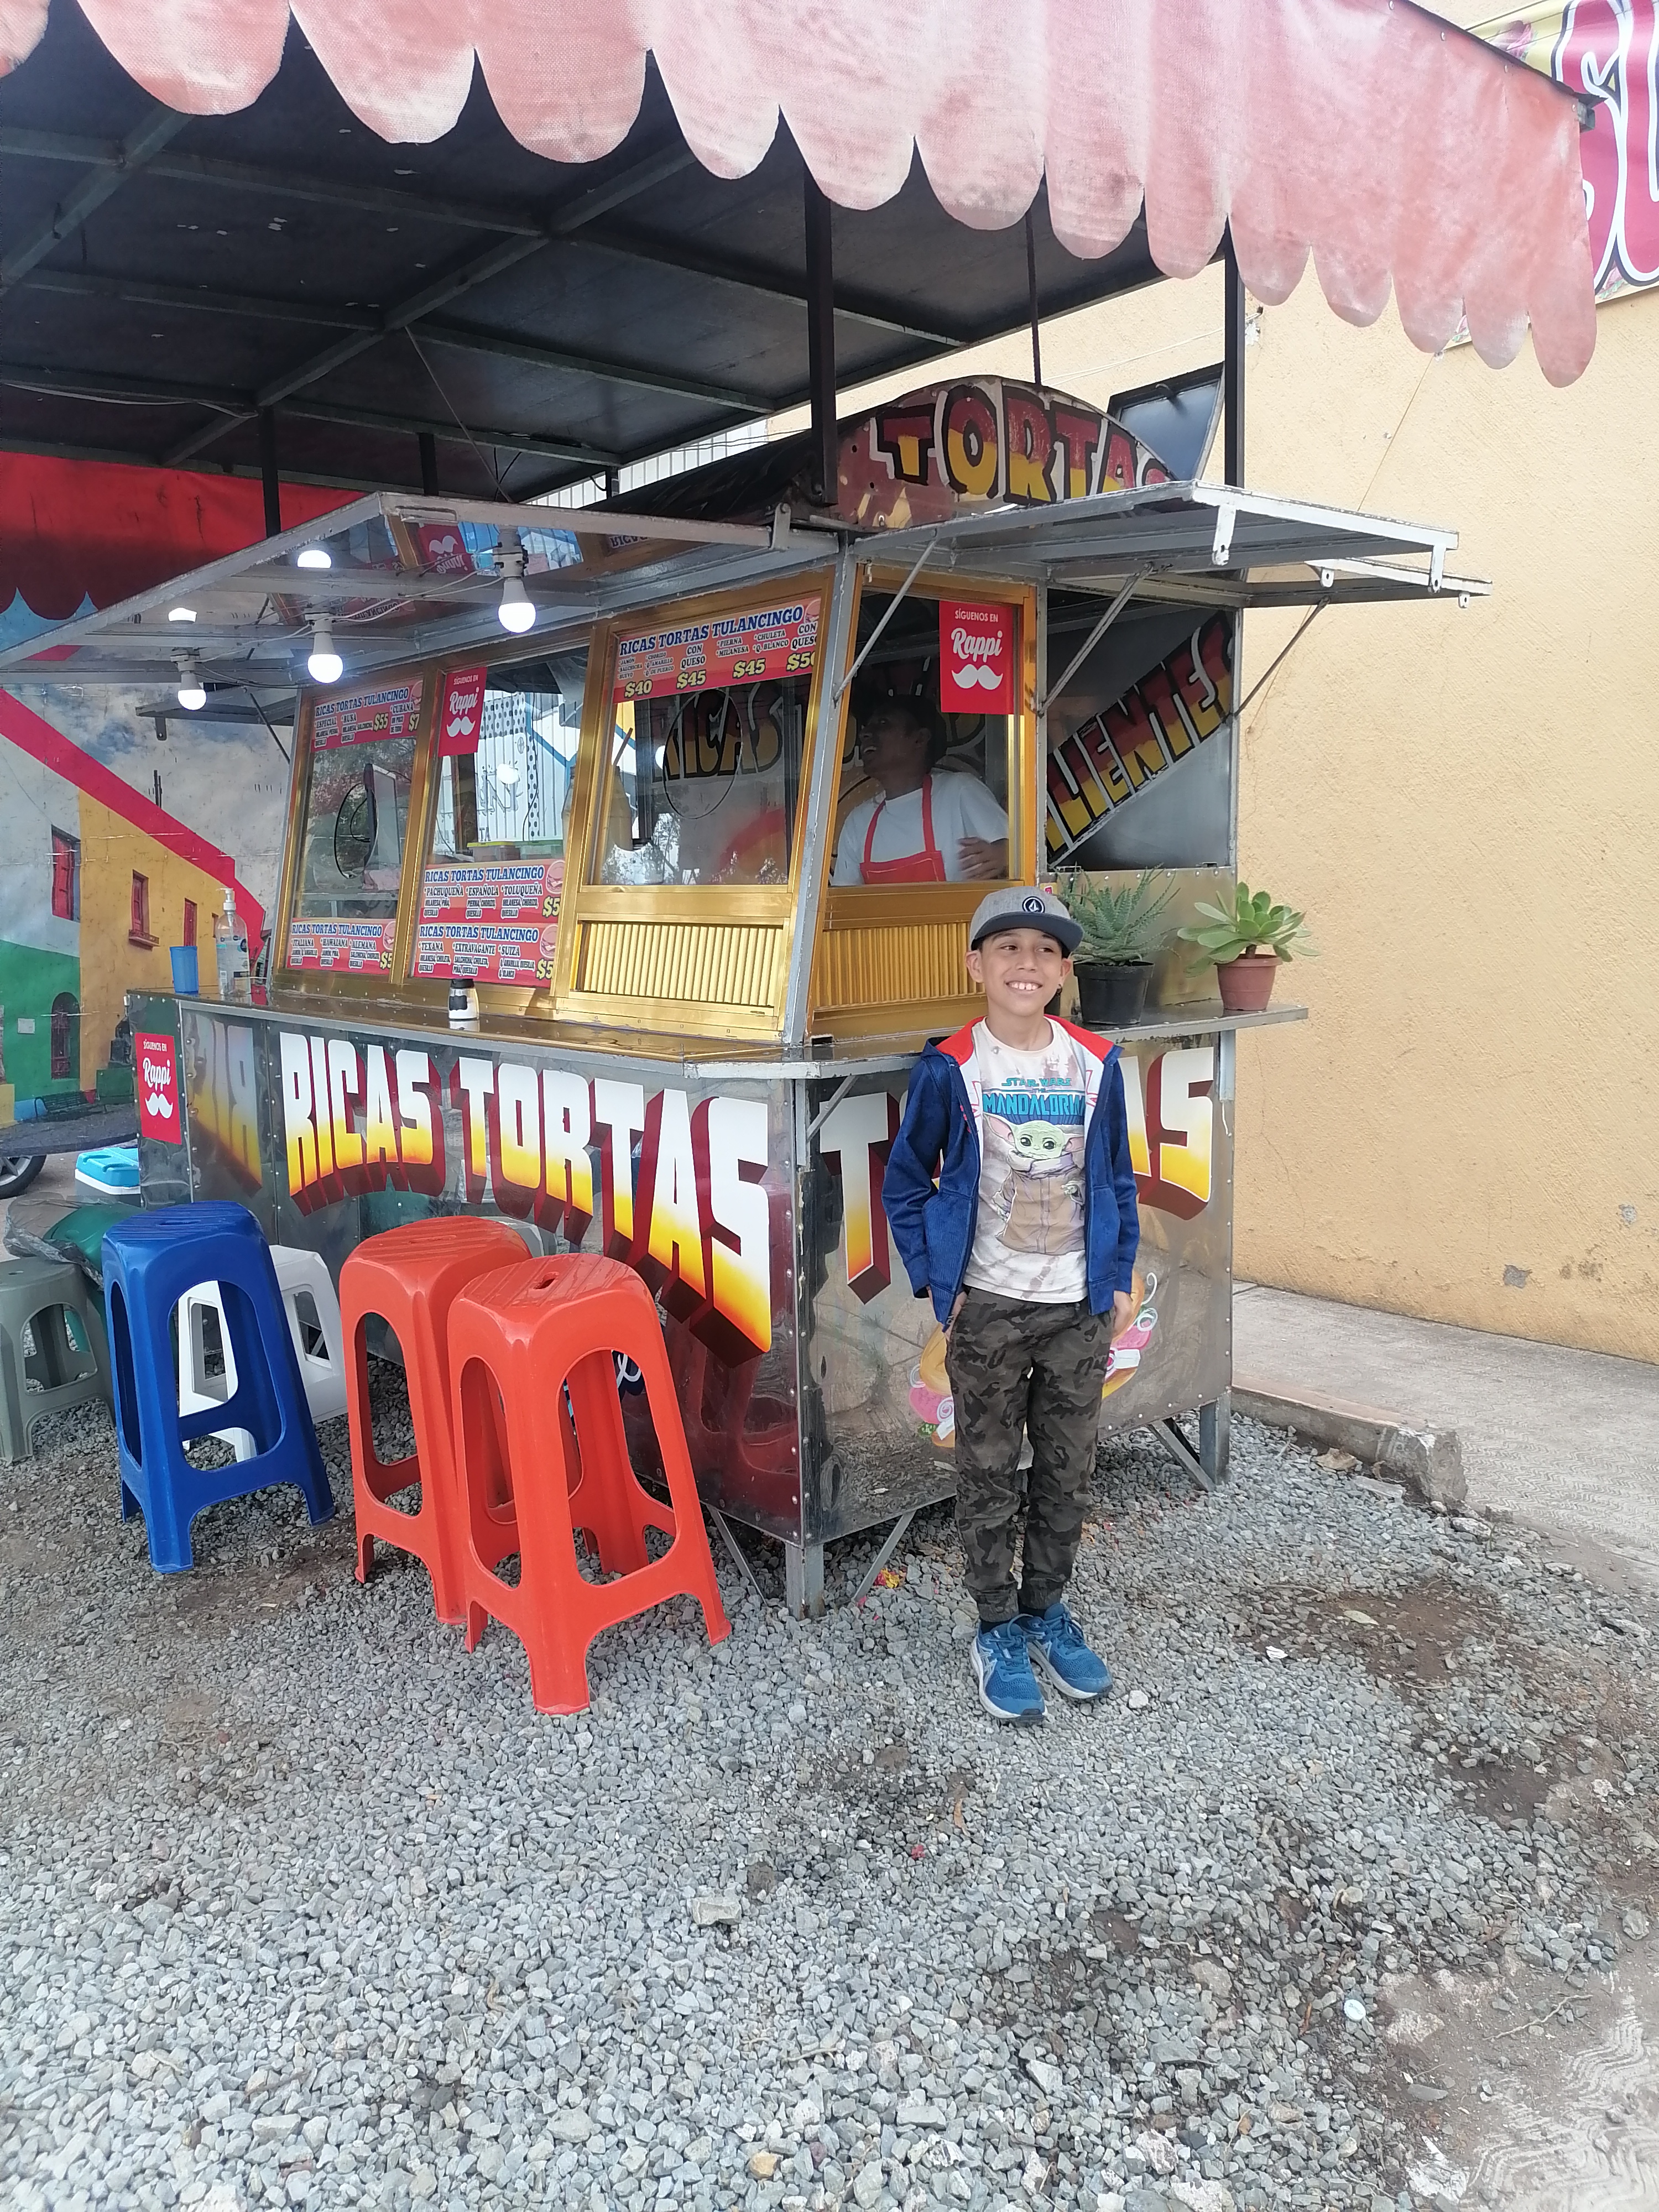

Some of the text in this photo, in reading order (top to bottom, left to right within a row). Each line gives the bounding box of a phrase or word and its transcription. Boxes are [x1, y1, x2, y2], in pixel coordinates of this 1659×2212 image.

[954, 608, 998, 622] SÍGUENOS EN
[620, 607, 803, 655] RICAS TORTAS TULANCINGO
[758, 630, 785, 640] CHULETA
[799, 623, 816, 634] CON
[721, 638, 742, 647] PIERNA
[764, 640, 789, 650] BLANCO
[951, 628, 1003, 662] Rappi
[687, 645, 702, 655] CON
[719, 646, 749, 656] MILANESA
[681, 656, 705, 668] QUESO
[733, 659, 765, 679] $45
[676, 670, 706, 689] $45
[624, 680, 653, 698] $40
[316, 688, 409, 717] RICAS TORTAS TULANCINGO
[450, 687, 479, 715] Rappi
[374, 713, 389, 731] $55
[425, 867, 544, 882] RICAS TORTAS TULANCINGO
[426, 883, 542, 897] PACHUQUEÑA ESPAÑOLA TOLUQUEÑA
[292, 924, 382, 936] RICAS TORTAS TULANCINGO
[420, 926, 538, 941] RICAS TORTAS TULANCINGO
[421, 942, 520, 956] TEXANA EXTRAVAGANTE SUIZA
[143, 1057, 171, 1092] Rappi
[1001, 1078, 1072, 1087] STAR WARS
[279, 1031, 772, 1354] RICAS TORTAS
